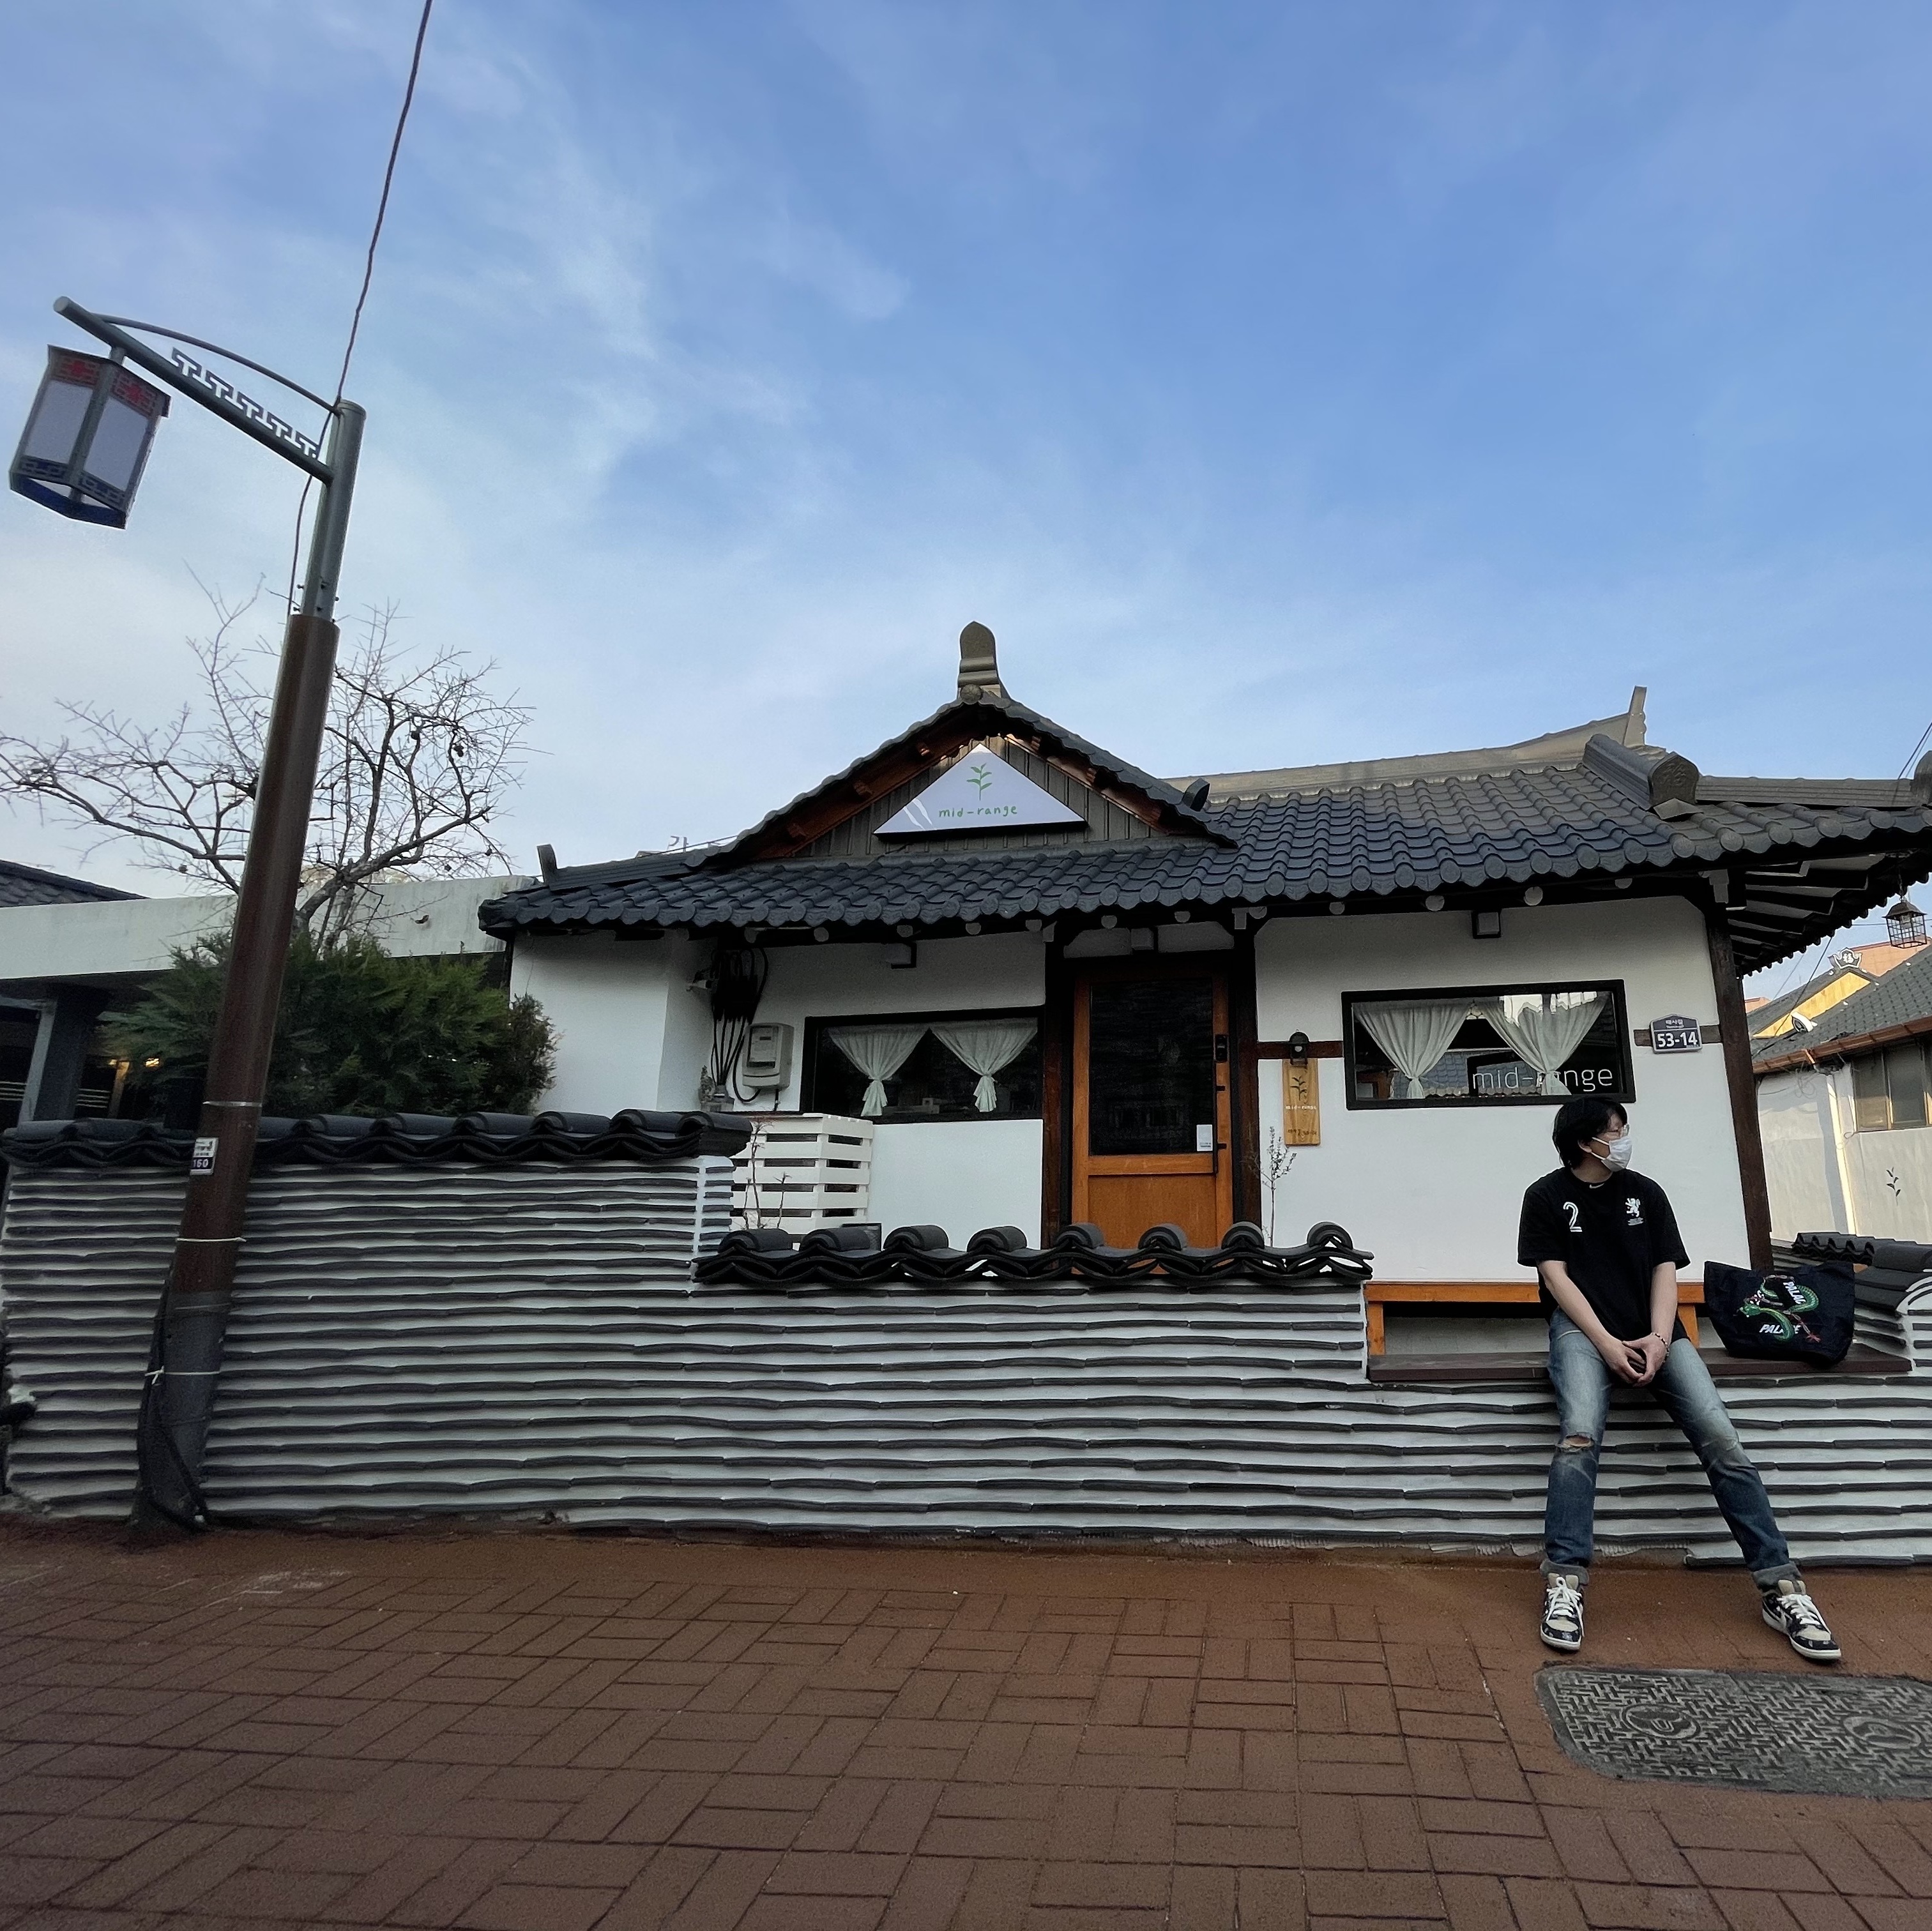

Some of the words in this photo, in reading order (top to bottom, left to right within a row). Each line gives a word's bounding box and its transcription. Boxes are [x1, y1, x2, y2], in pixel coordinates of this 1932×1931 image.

[939, 805, 1017, 817] mid-range
[1657, 1031, 1698, 1048] 53-14
[1563, 1201, 1583, 1232] 2
